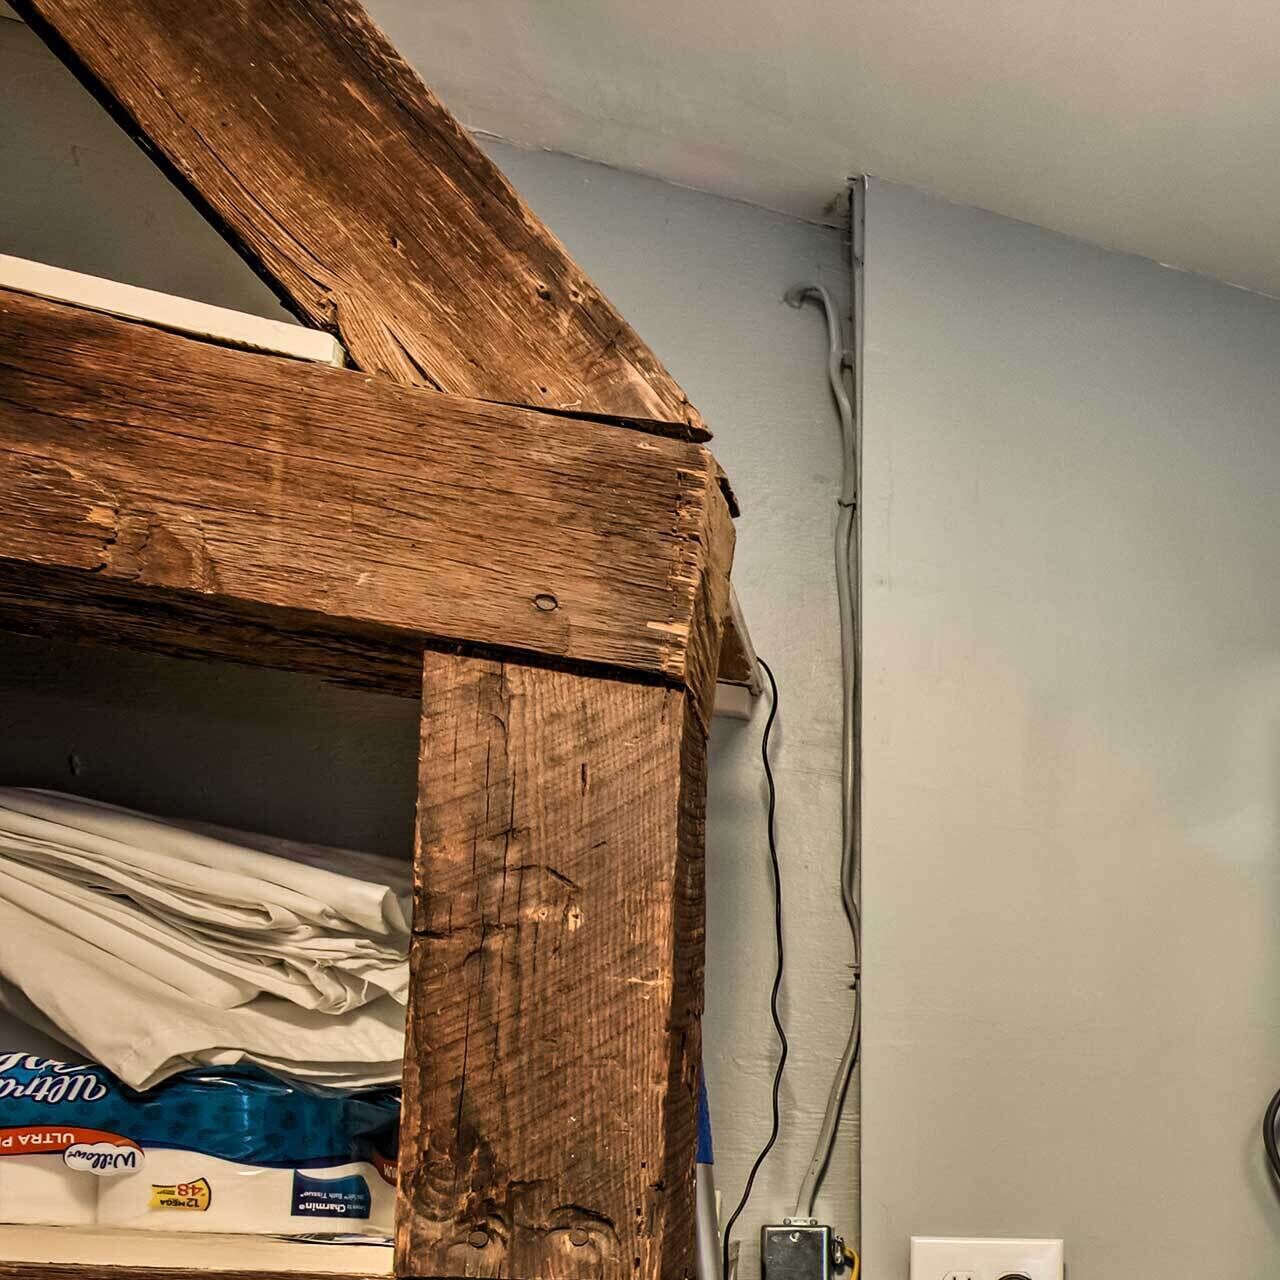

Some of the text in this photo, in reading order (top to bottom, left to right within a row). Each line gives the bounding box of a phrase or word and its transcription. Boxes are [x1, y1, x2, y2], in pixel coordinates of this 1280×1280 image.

[18, 1132, 75, 1145] ULTRA
[71, 1151, 136, 1169] Willow
[177, 1183, 204, 1197] 48
[160, 1197, 200, 1208] 12 MEGA
